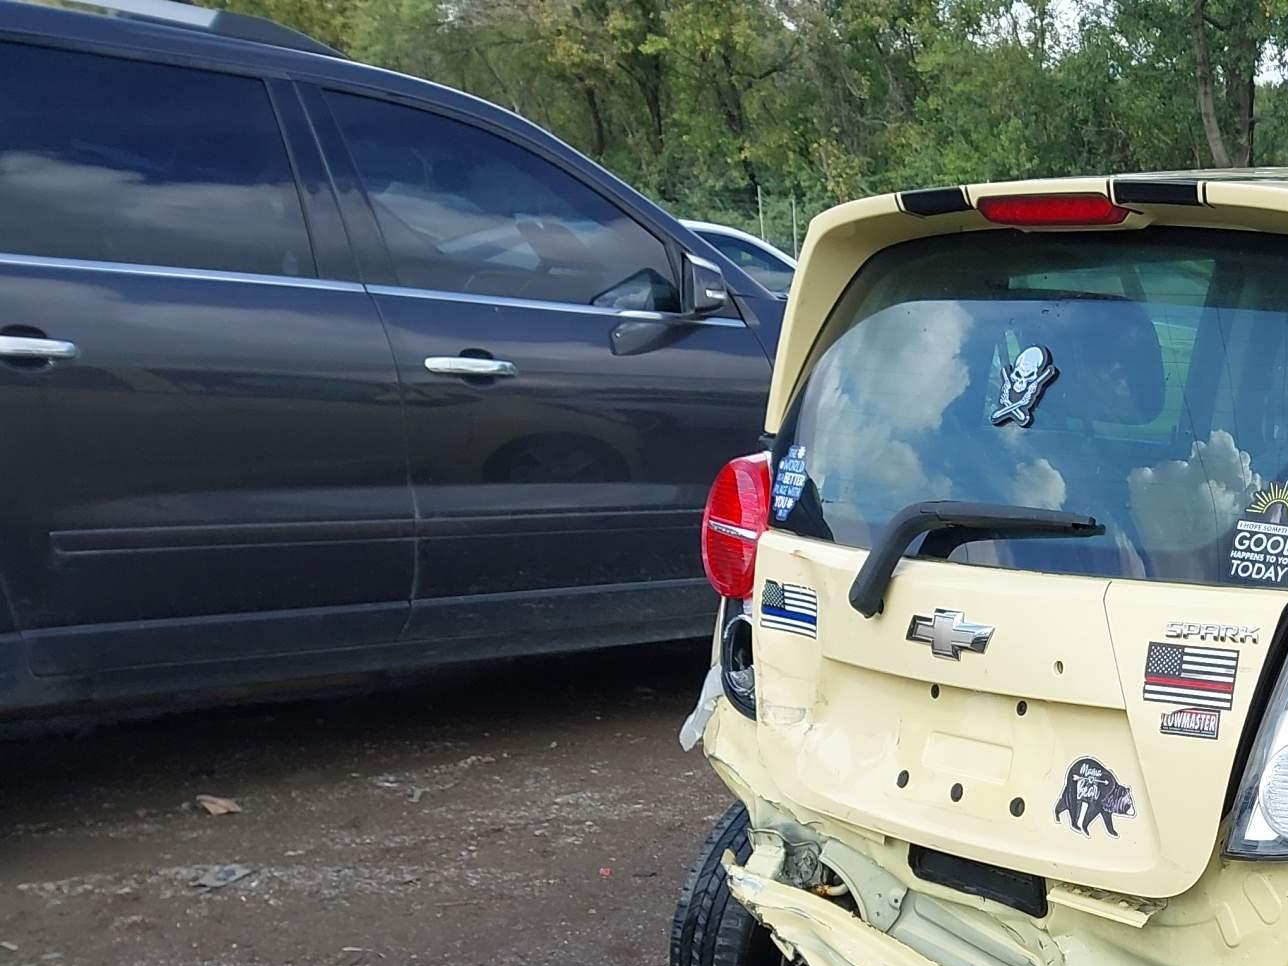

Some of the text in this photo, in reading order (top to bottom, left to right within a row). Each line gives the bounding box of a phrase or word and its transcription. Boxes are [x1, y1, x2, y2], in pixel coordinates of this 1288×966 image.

[784, 460, 805, 473] WORLD
[783, 472, 806, 487] BETTER
[774, 496, 788, 509] YOU
[1243, 522, 1261, 530] HOPE
[1230, 549, 1264, 562] HAPPENS
[1265, 555, 1277, 563] TO
[1230, 559, 1288, 582] TODAY
[1165, 621, 1260, 644] SPARK
[1080, 763, 1103, 777] Mama
